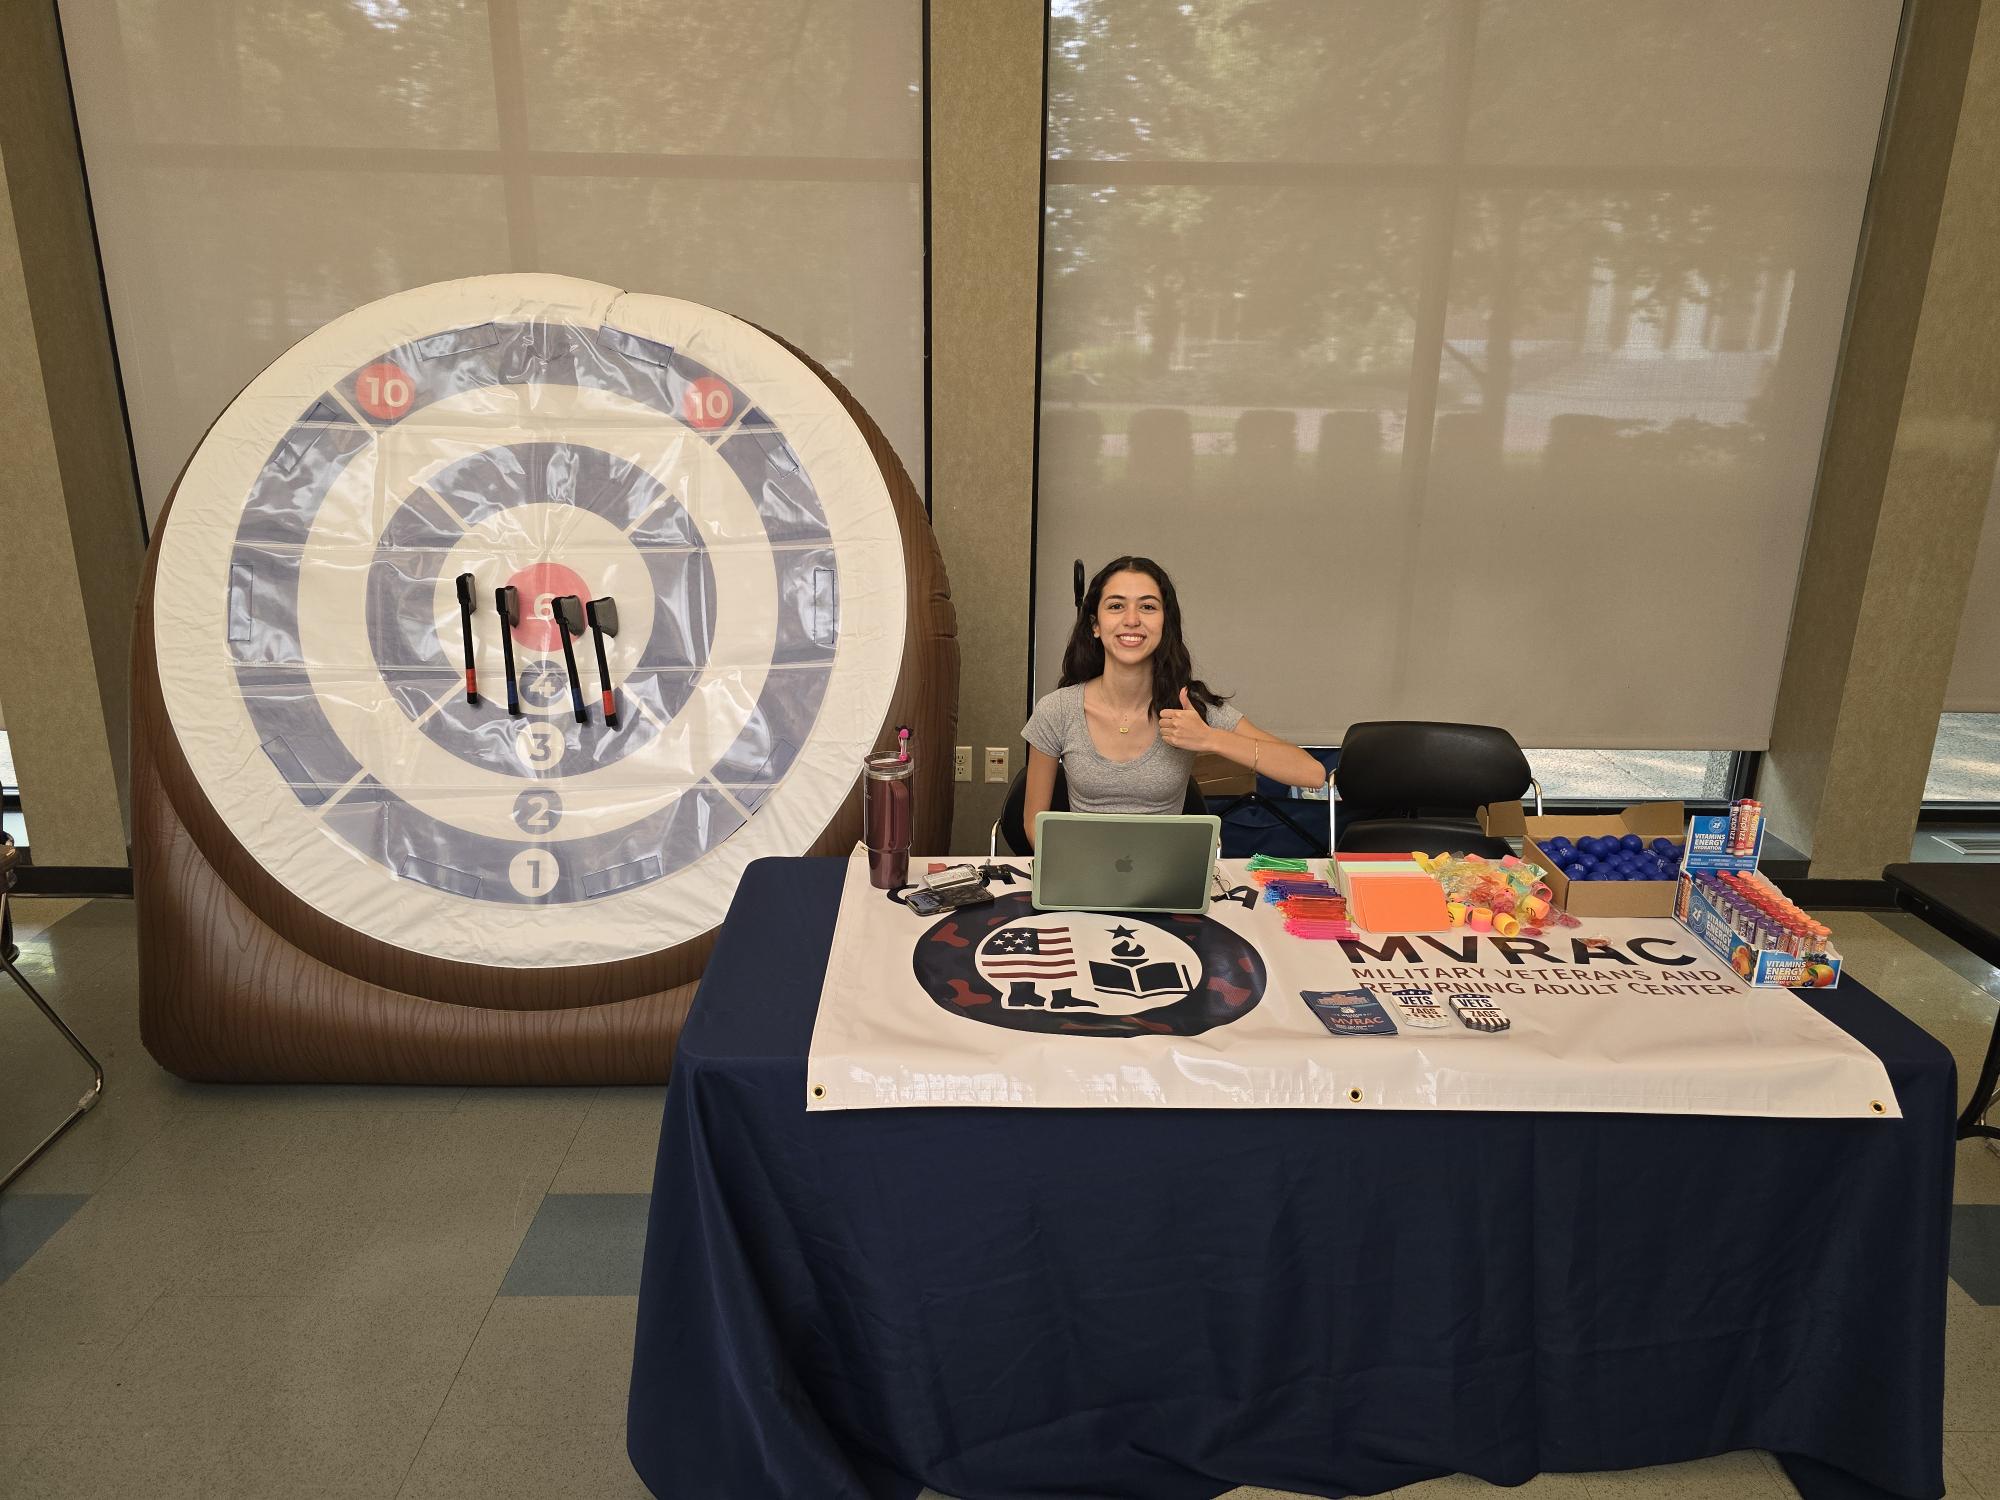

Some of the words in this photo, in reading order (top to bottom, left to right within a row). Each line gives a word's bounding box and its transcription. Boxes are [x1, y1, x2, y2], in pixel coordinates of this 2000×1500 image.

[366, 377, 409, 408] 10
[691, 390, 728, 419] 10
[527, 671, 556, 697] 4
[529, 733, 552, 762] 3
[526, 796, 550, 826] 2
[1739, 816, 1748, 841] zipfizz
[526, 860, 541, 889] 1
[1706, 910, 1733, 938] VITAMINS
[1706, 920, 1733, 947] ENERGY
[1337, 935, 1698, 967] MVRAC
[1351, 967, 1487, 979] MILITARY
[1494, 968, 1652, 981] VETERANS
[1660, 970, 1722, 981] AND
[1766, 967, 1805, 975] ENERGY
[1359, 982, 1526, 995] RETURNING
[1533, 983, 1617, 995] ADULT
[1627, 982, 1743, 996] CENTER
[1399, 996, 1434, 1006] VETS
[1408, 1007, 1439, 1015] ZAGS
[1457, 998, 1493, 1008] VETS
[1469, 1010, 1500, 1018] ZAGS
[1330, 1016, 1384, 1025] MVRAC
